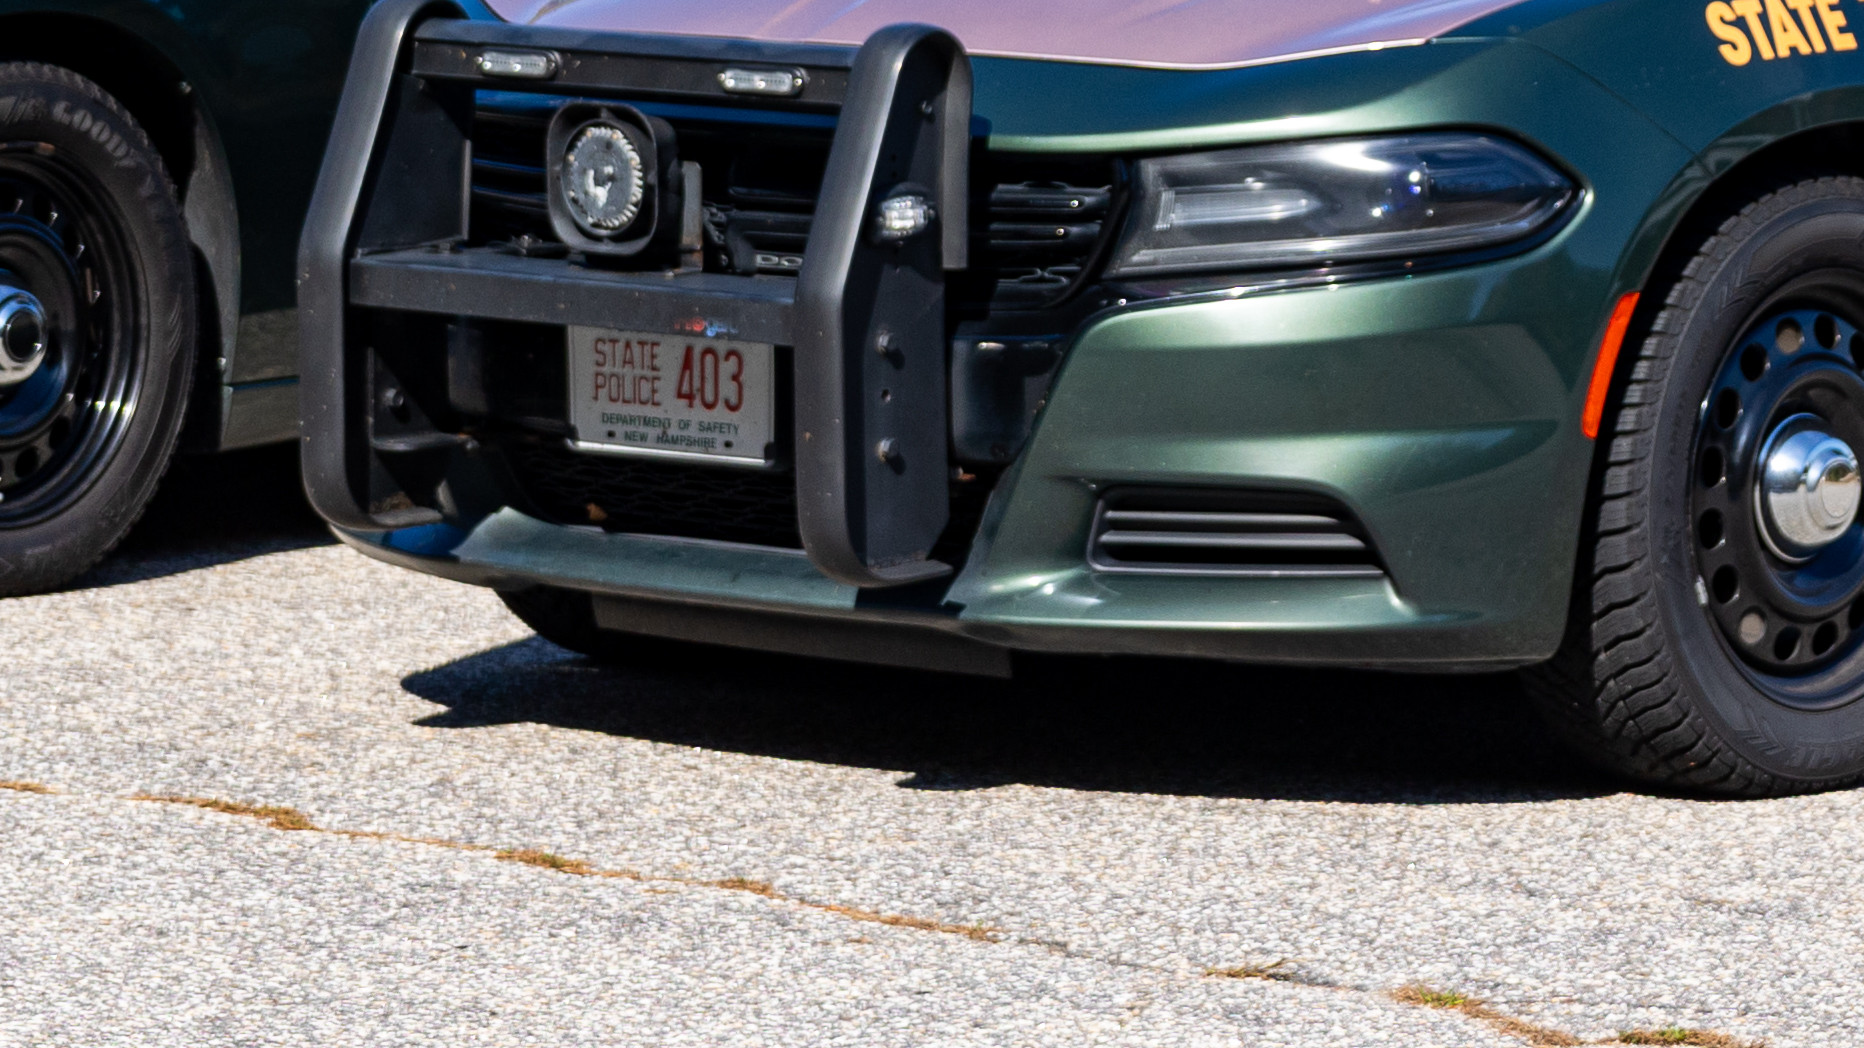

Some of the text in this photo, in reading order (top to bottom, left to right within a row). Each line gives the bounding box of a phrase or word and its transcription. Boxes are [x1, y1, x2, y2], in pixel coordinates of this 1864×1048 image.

[594, 338, 662, 373] STATE
[592, 372, 662, 407] POLICE
[676, 343, 745, 414] 403
[601, 412, 740, 435] DEPARTMENT OF SAFETY
[624, 431, 717, 449] NEW HAMPSHIRE
